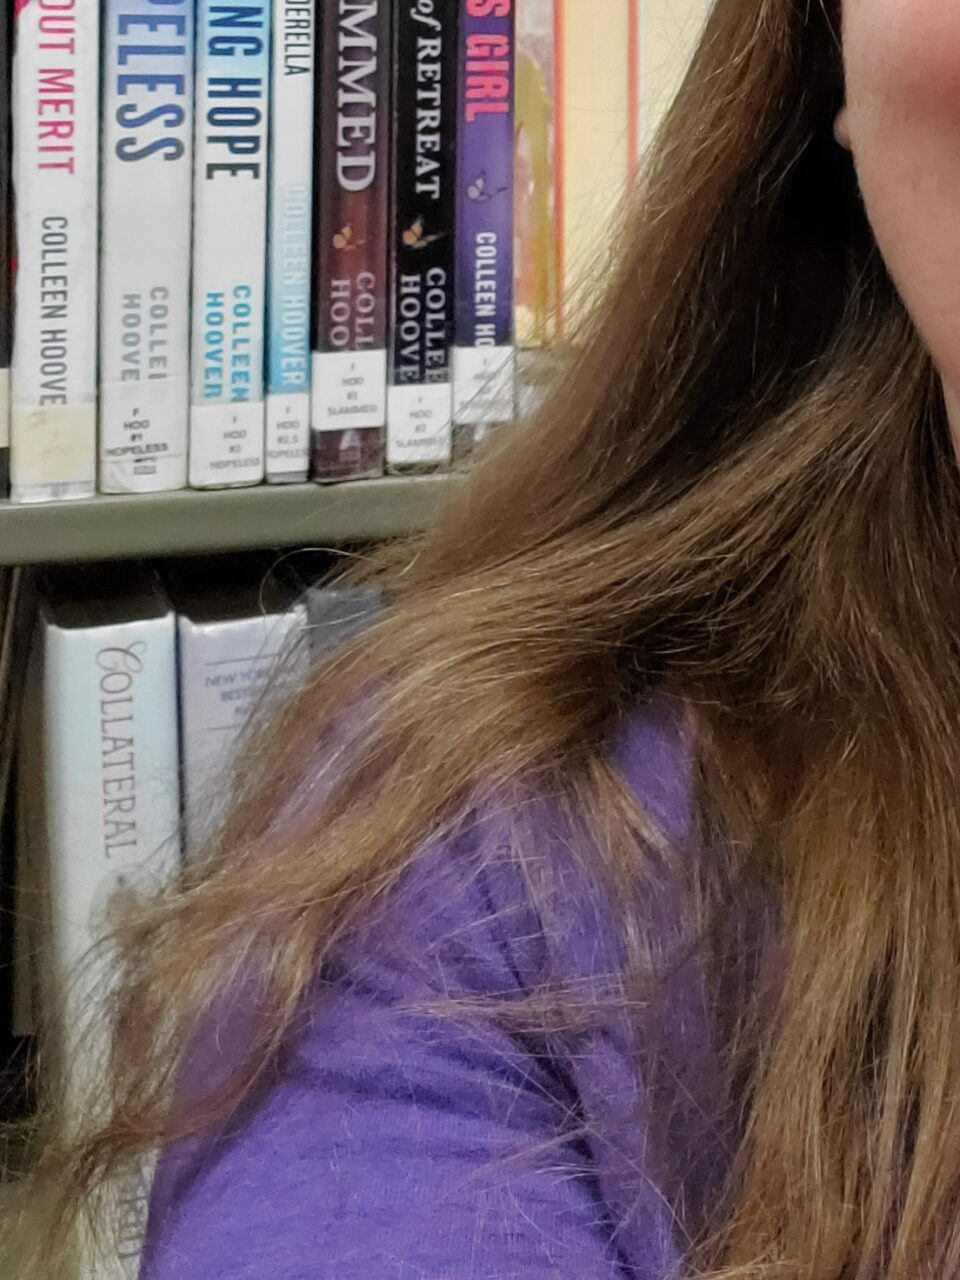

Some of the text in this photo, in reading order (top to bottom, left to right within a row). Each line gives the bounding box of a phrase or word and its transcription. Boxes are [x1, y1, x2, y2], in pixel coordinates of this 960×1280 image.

[37, 69, 75, 174] MERIT
[206, 77, 262, 180] HOPE
[415, 37, 442, 200] RETREAT
[466, 34, 510, 122] GIRL
[40, 216, 68, 320] COLLEEN
[281, 185, 306, 387] COLLEEN HOOVER
[475, 231, 497, 317] COLLEEN
[204, 292, 224, 399] HOOVER
[123, 420, 150, 431] HOO
[95, 639, 148, 858] COLLATERAL
